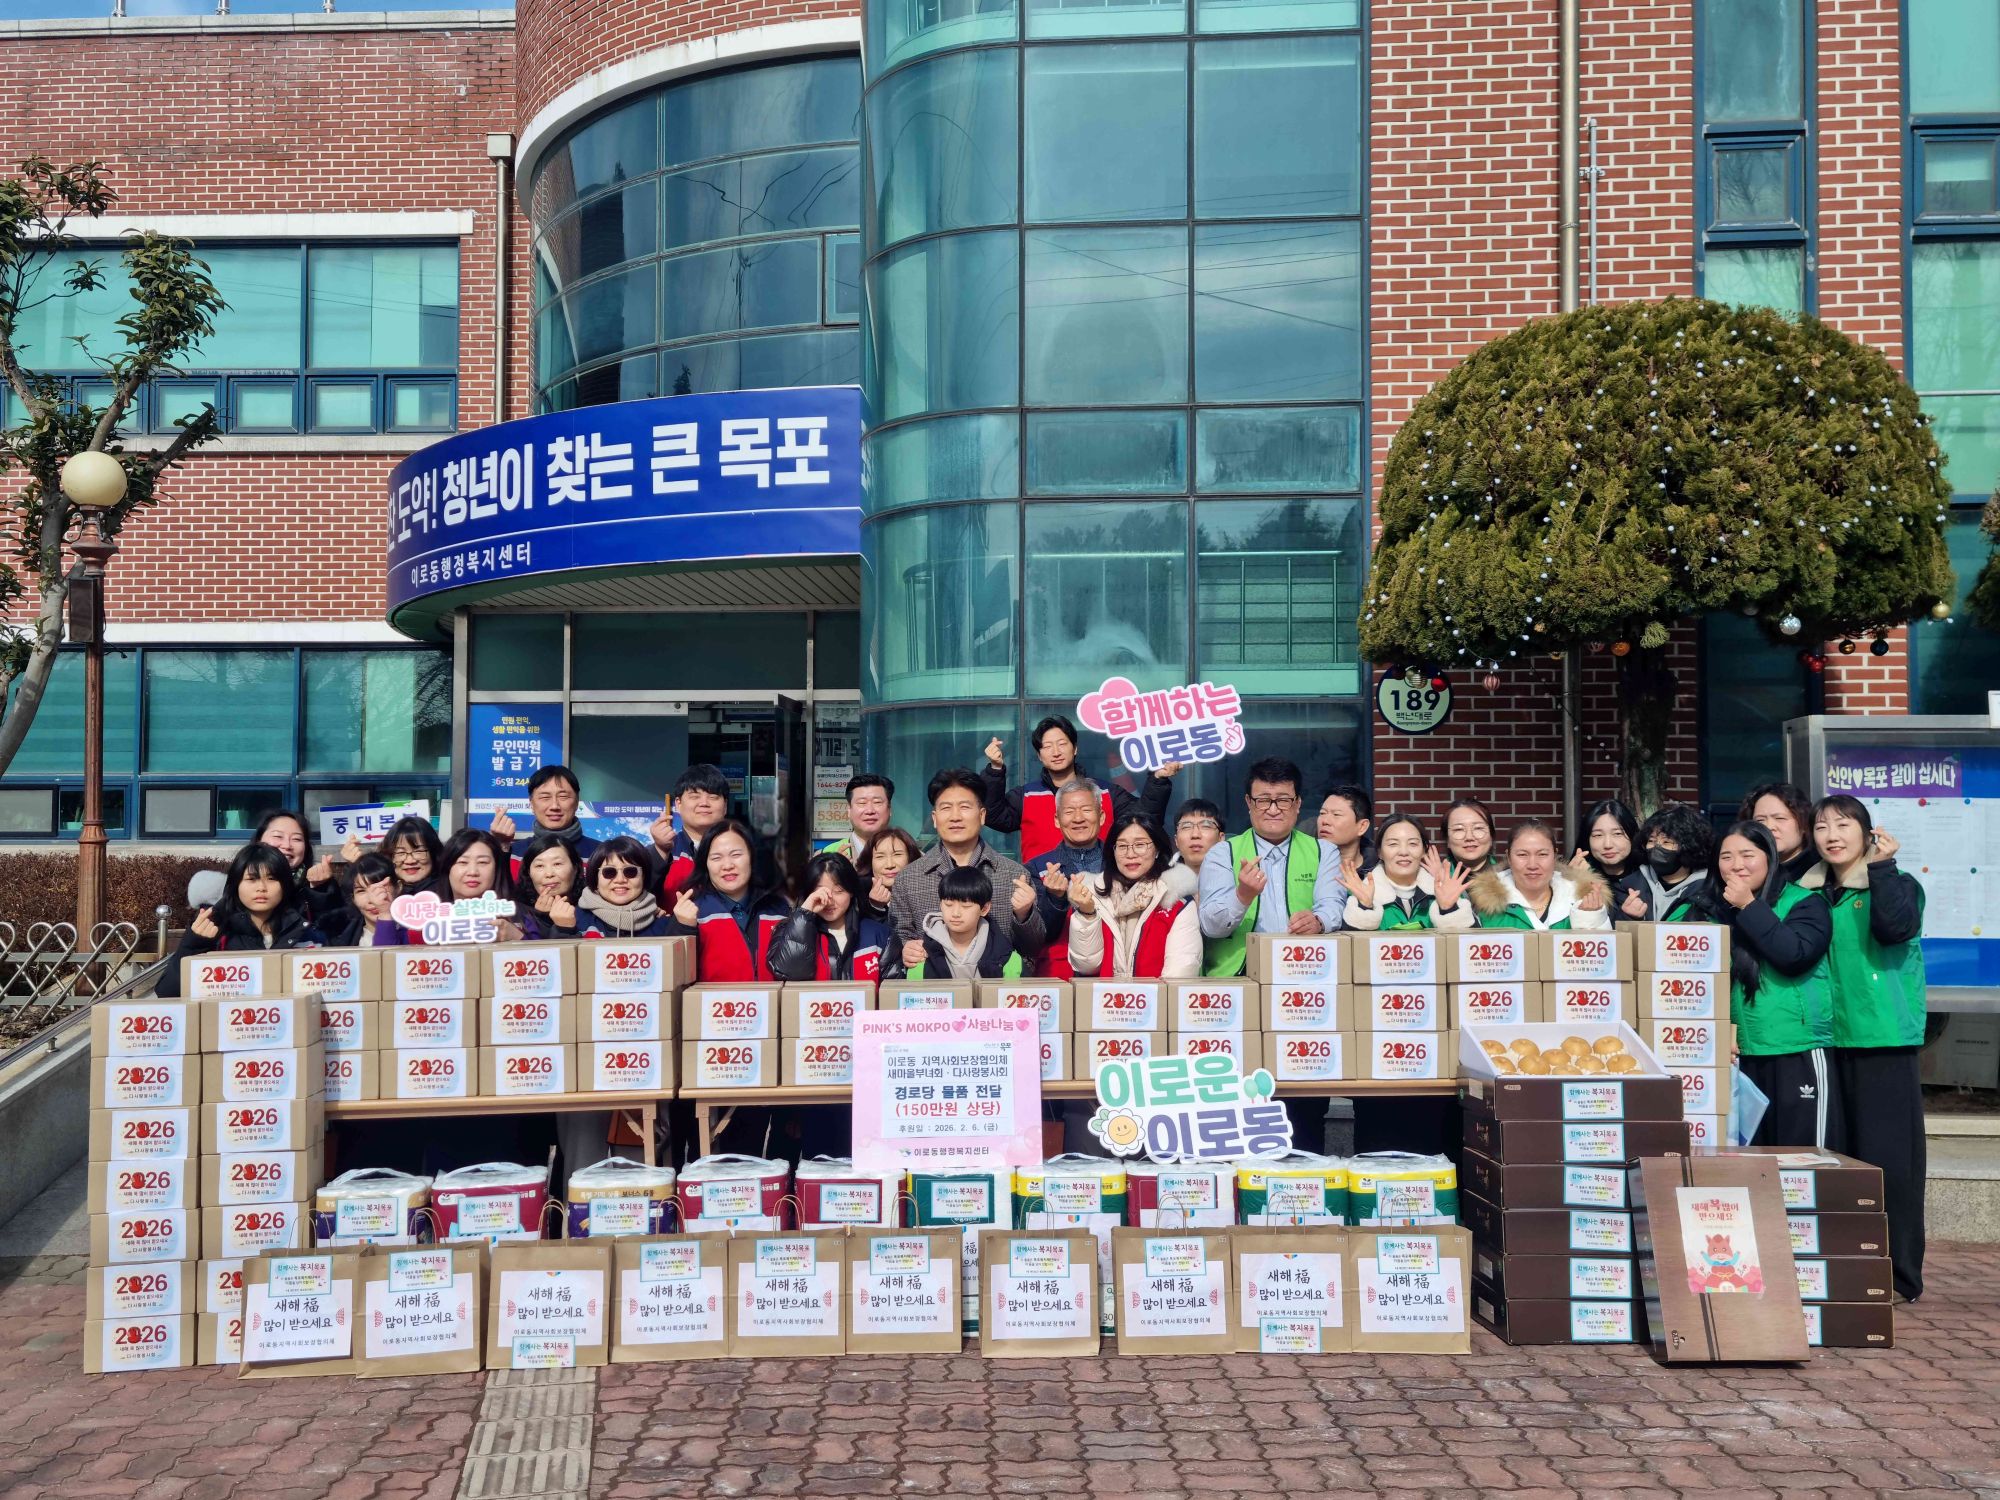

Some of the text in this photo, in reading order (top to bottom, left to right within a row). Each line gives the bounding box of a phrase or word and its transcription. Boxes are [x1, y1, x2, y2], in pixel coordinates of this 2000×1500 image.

[398, 468, 437, 543] 도약!
[443, 443, 533, 526] 청년이
[547, 431, 634, 507] 찾는
[651, 421, 700, 495] 큰
[719, 416, 830, 489] 목포
[411, 541, 532, 589] 이로동행정복지센터
[1390, 689, 1441, 711] 189
[1101, 684, 1239, 736] 함께하는
[491, 740, 541, 754] 무인민원
[1123, 722, 1223, 769] 이로동
[491, 777, 514, 787] 365일
[1891, 762, 1916, 787] 같이
[1919, 762, 1956, 789] 삽시다
[404, 900, 513, 918] 사랑을 실천하는
[424, 918, 496, 941] 이로동
[863, 1022, 950, 1034] PINK'S MOKPO
[967, 1018, 1014, 1032] 사랑나눔
[887, 1055, 1008, 1067] 이로동 지역사회보장협의체
[887, 1066, 1008, 1079] 새마을부녀회 다사랑봉사회
[1100, 1055, 1240, 1108] 이로운
[895, 1084, 1002, 1100] 경로당 물품 전달
[896, 1101, 1001, 1117] (150만원 상당)
[1147, 1105, 1289, 1159] 이로동
[1691, 1202, 1709, 1211] 새해
[1722, 1201, 1740, 1212] 많이
[1698, 1212, 1734, 1222] 받으세요
[964, 1242, 977, 1255] 福
[1267, 1269, 1310, 1284] 새해 福
[1386, 1274, 1430, 1289] 새해 福
[528, 1286, 572, 1302] 새해 福
[649, 1283, 692, 1299] 새해 福
[1017, 1280, 1060, 1295] 새해 福
[1259, 1288, 1324, 1301] 많이 받으세요
[275, 1298, 319, 1313] 새해 福
[1008, 1300, 1073, 1312] 많이 받으세요
[1378, 1293, 1444, 1306] 많이 받으세요
[518, 1305, 584, 1319] 많이 받으세요
[640, 1303, 705, 1317] 많이 받으세요
[264, 1317, 333, 1332] 많이 받으세요
